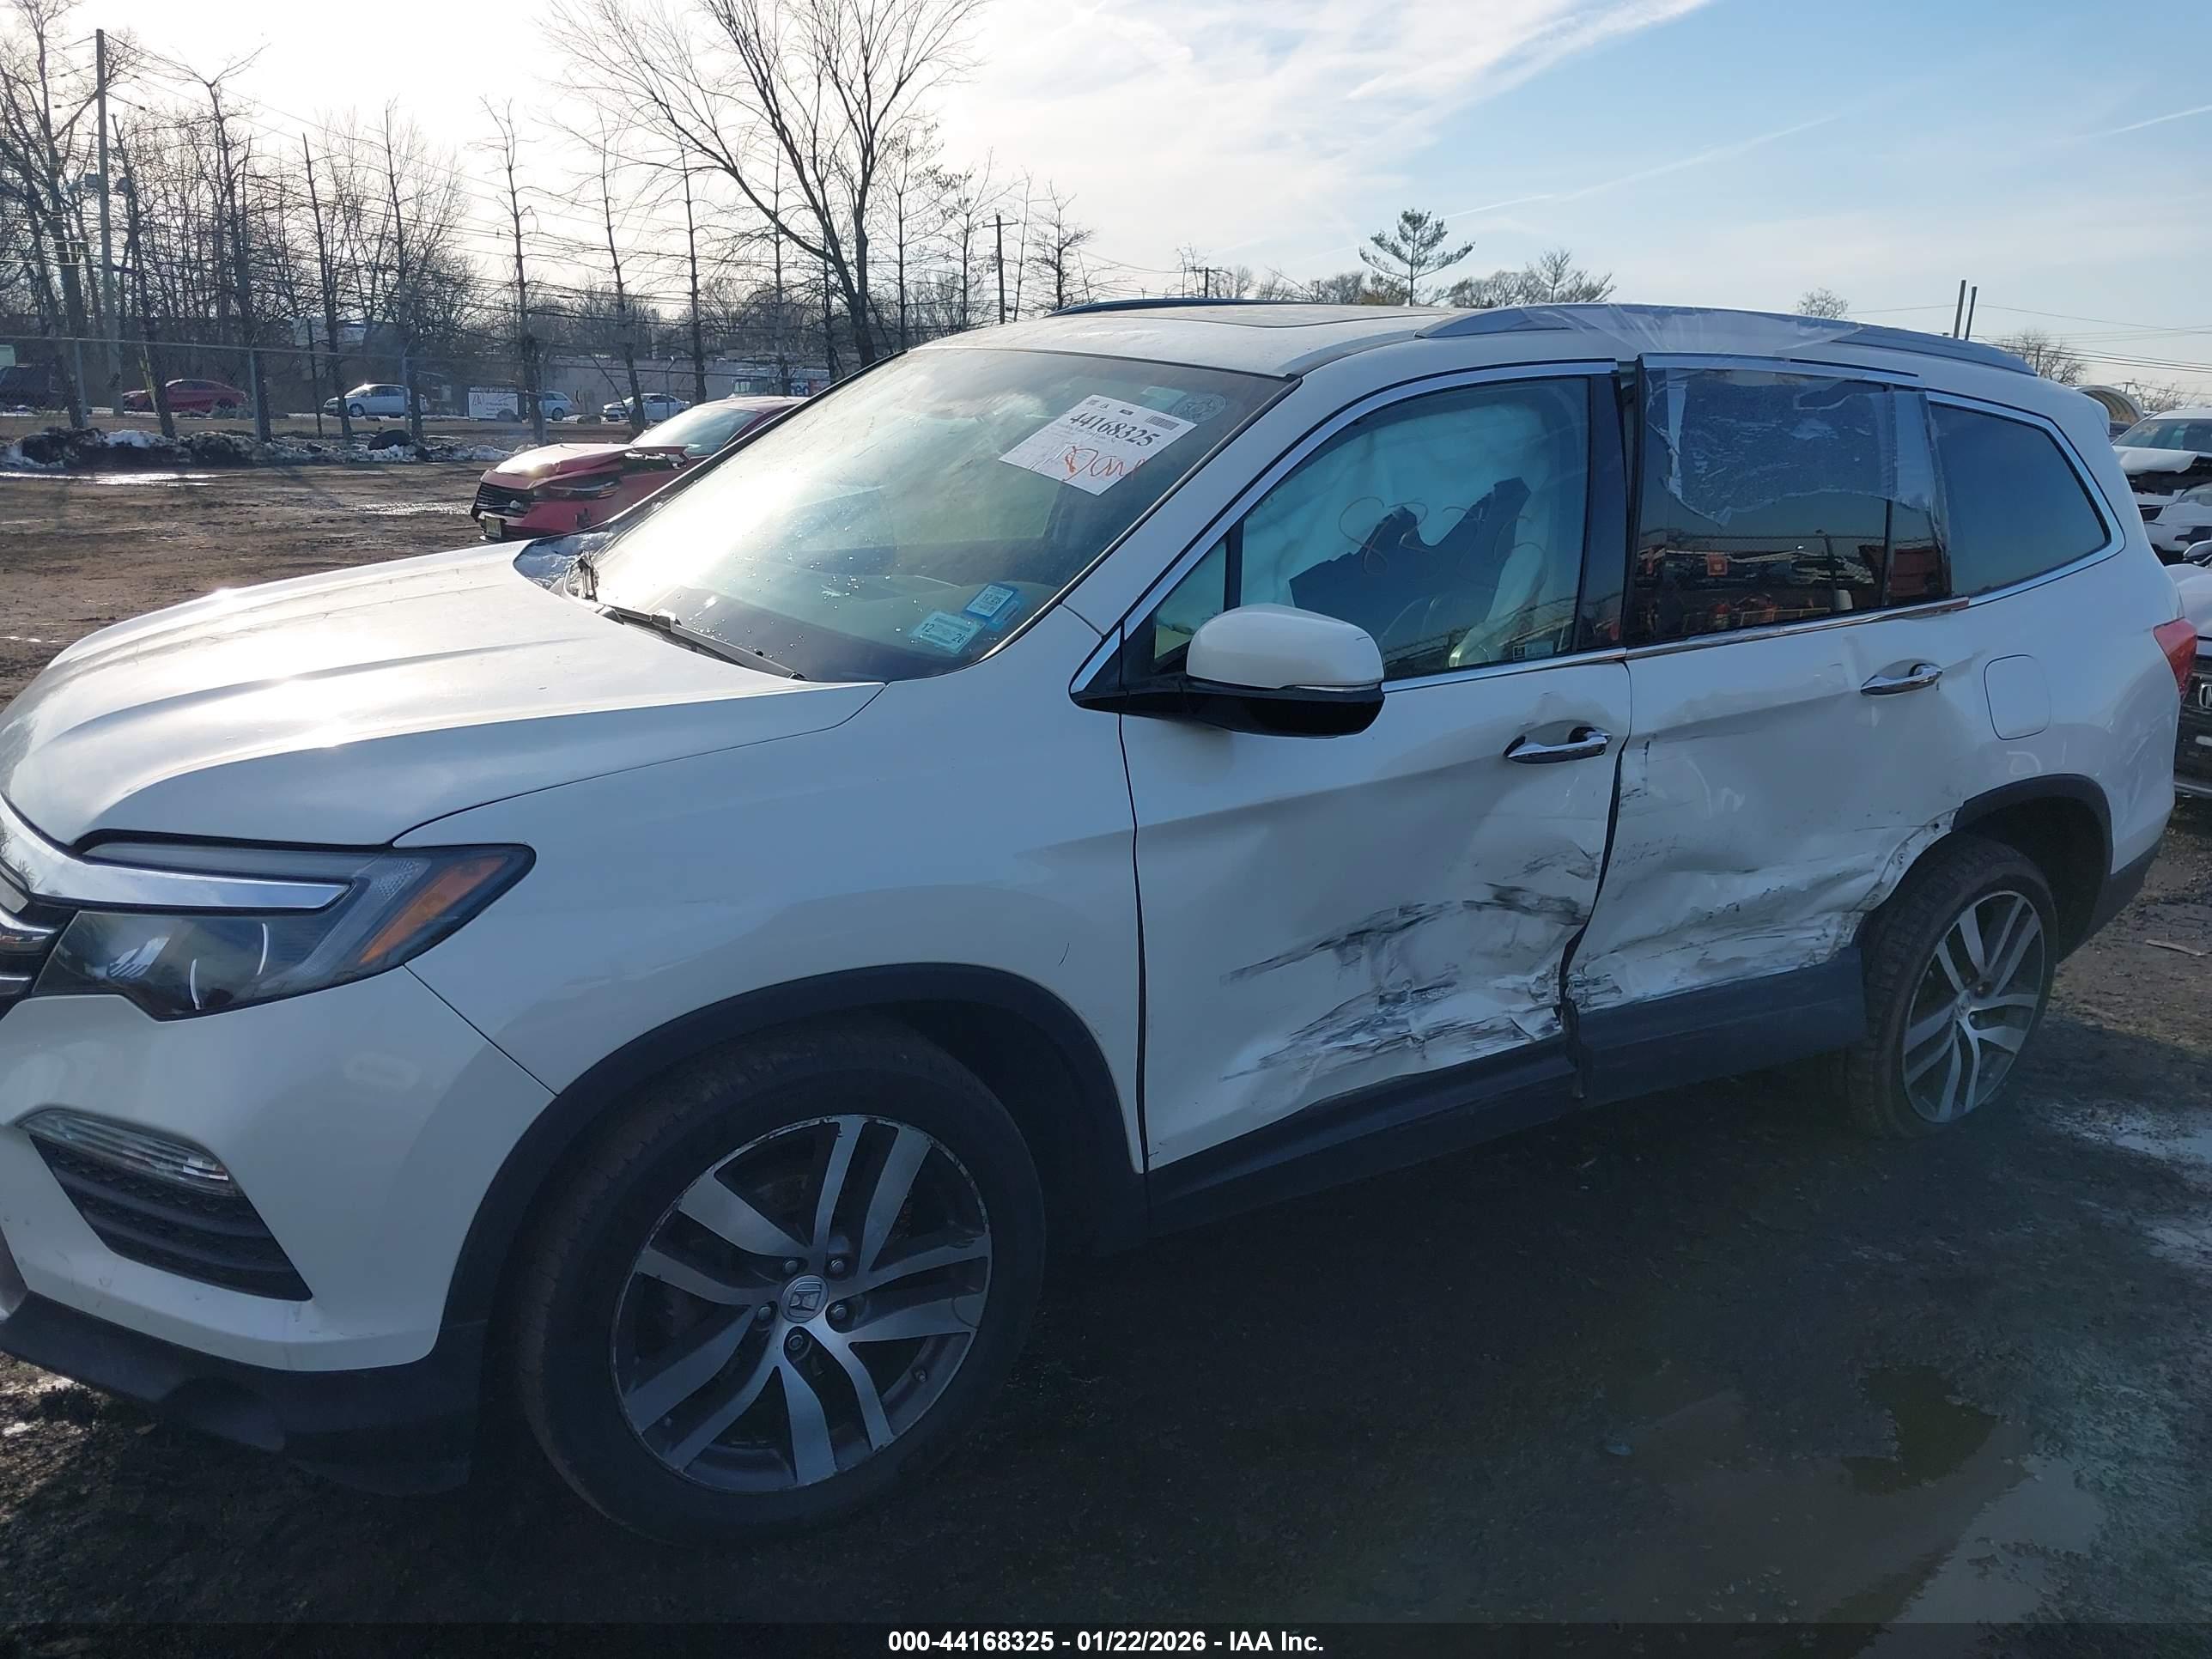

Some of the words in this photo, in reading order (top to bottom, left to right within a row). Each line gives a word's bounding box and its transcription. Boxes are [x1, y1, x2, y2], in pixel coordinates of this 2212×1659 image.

[1069, 412, 1162, 447] 44168325
[921, 623, 935, 633] 12
[951, 633, 966, 644] 26
